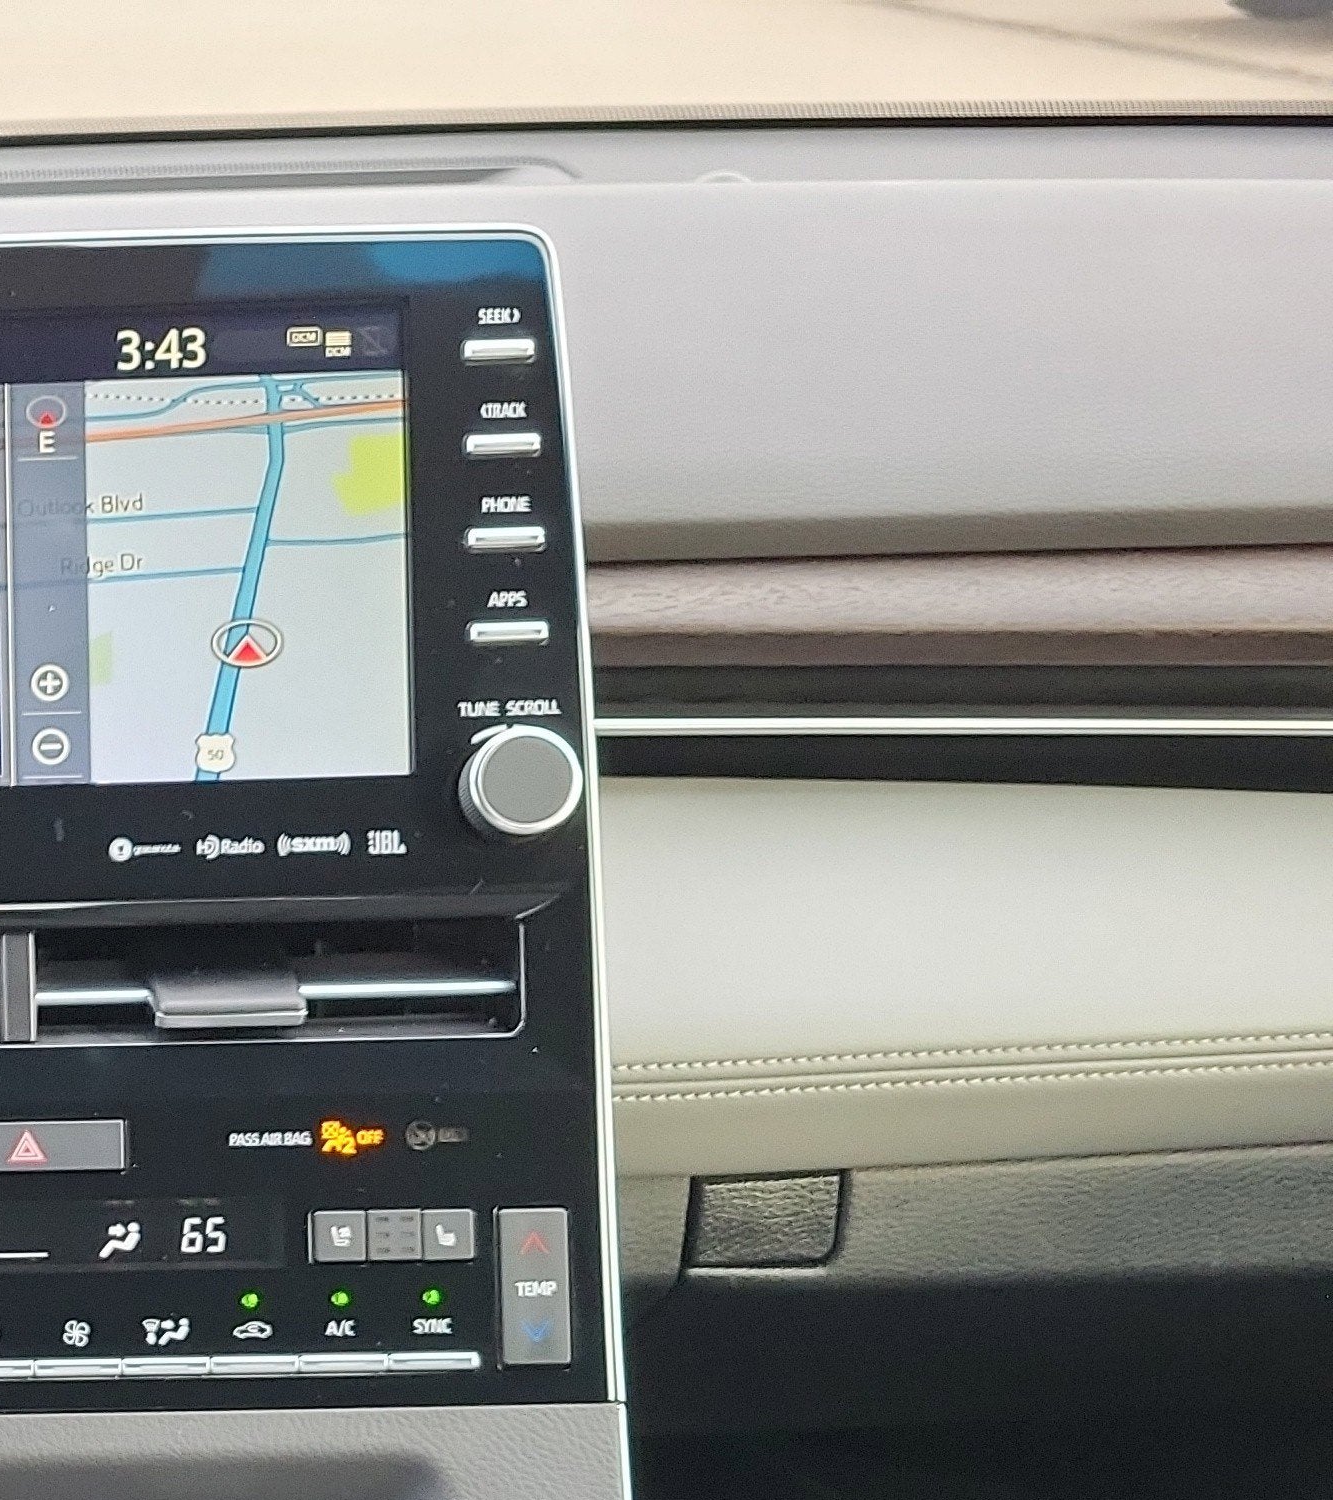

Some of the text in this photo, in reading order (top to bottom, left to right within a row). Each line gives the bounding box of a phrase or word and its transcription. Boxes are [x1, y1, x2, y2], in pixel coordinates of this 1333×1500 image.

[116, 327, 207, 371] 3:43
[486, 402, 526, 419] TRACK
[38, 432, 55, 453] E
[101, 493, 143, 513] Blvd
[481, 495, 531, 513] PHONE
[121, 553, 142, 571] Dr
[488, 591, 527, 608] APPS
[458, 699, 561, 717] TUNE SCROLL
[221, 836, 265, 854] Radio
[367, 829, 407, 854] JBL
[229, 1132, 259, 1147] PASS
[283, 1131, 313, 1146] BAG
[356, 1130, 383, 1145] OFF
[181, 1217, 227, 1253] 65
[515, 1281, 557, 1298] TEMP
[325, 1319, 356, 1337] A/C
[413, 1318, 452, 1335] SYNC
